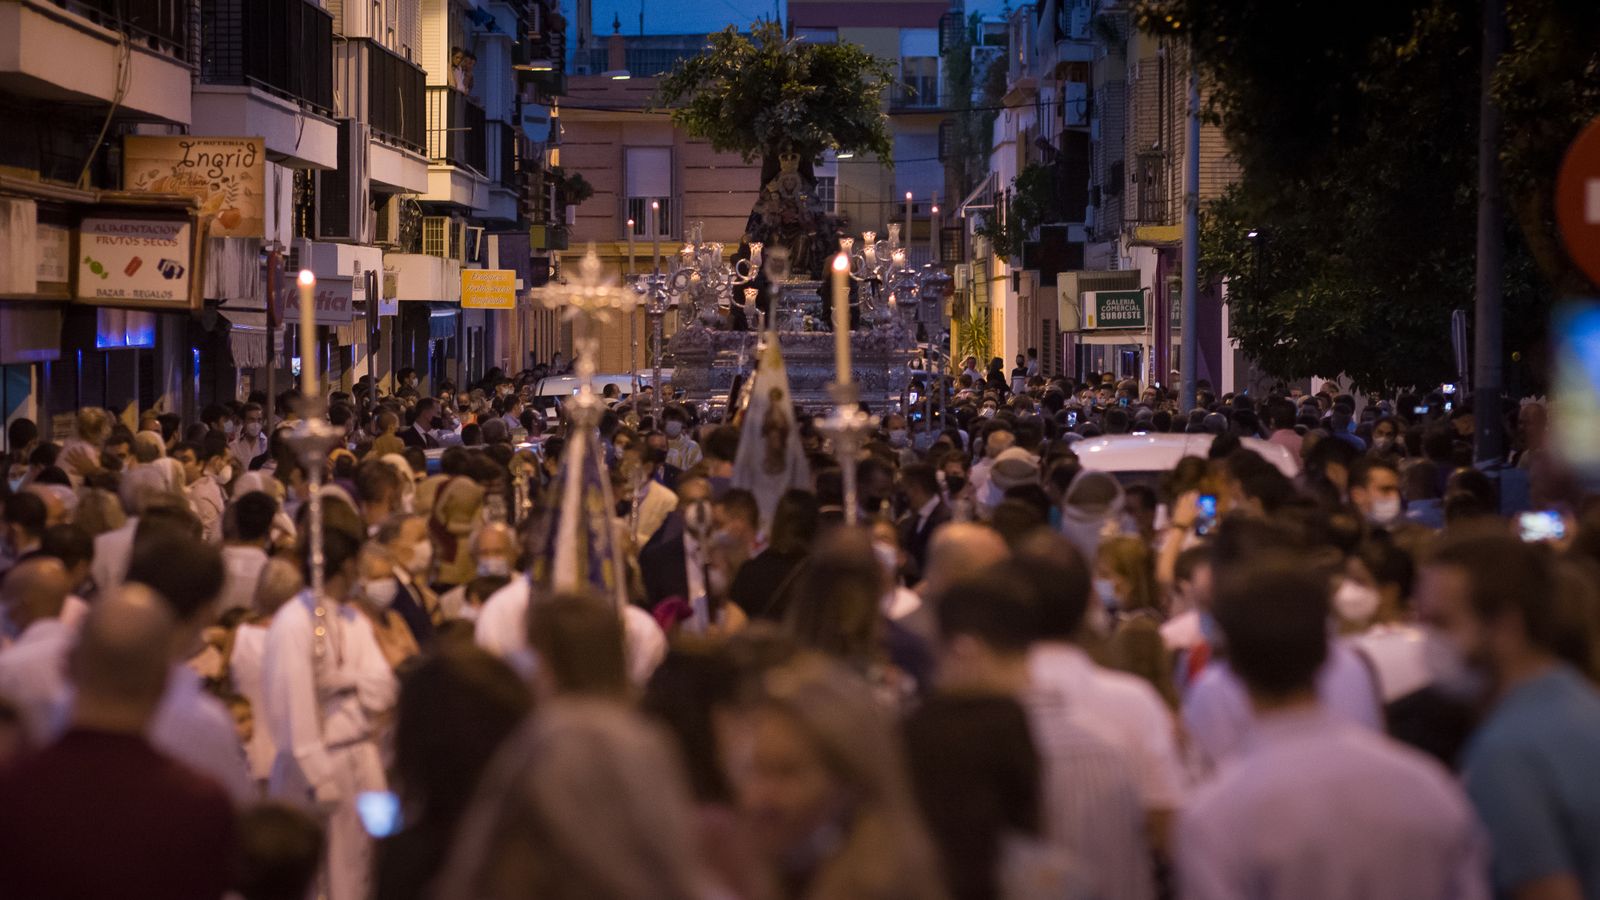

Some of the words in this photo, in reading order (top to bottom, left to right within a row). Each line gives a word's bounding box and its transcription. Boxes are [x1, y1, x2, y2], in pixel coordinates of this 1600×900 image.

[177, 142, 257, 179] Ingrid
[96, 236, 140, 246] FRUTOS
[143, 238, 178, 247] SECOS
[96, 288, 125, 297] BAZAR
[133, 290, 174, 299] REGALOS
[285, 288, 348, 312] Ktia
[1100, 311, 1141, 320] SUROESTE
